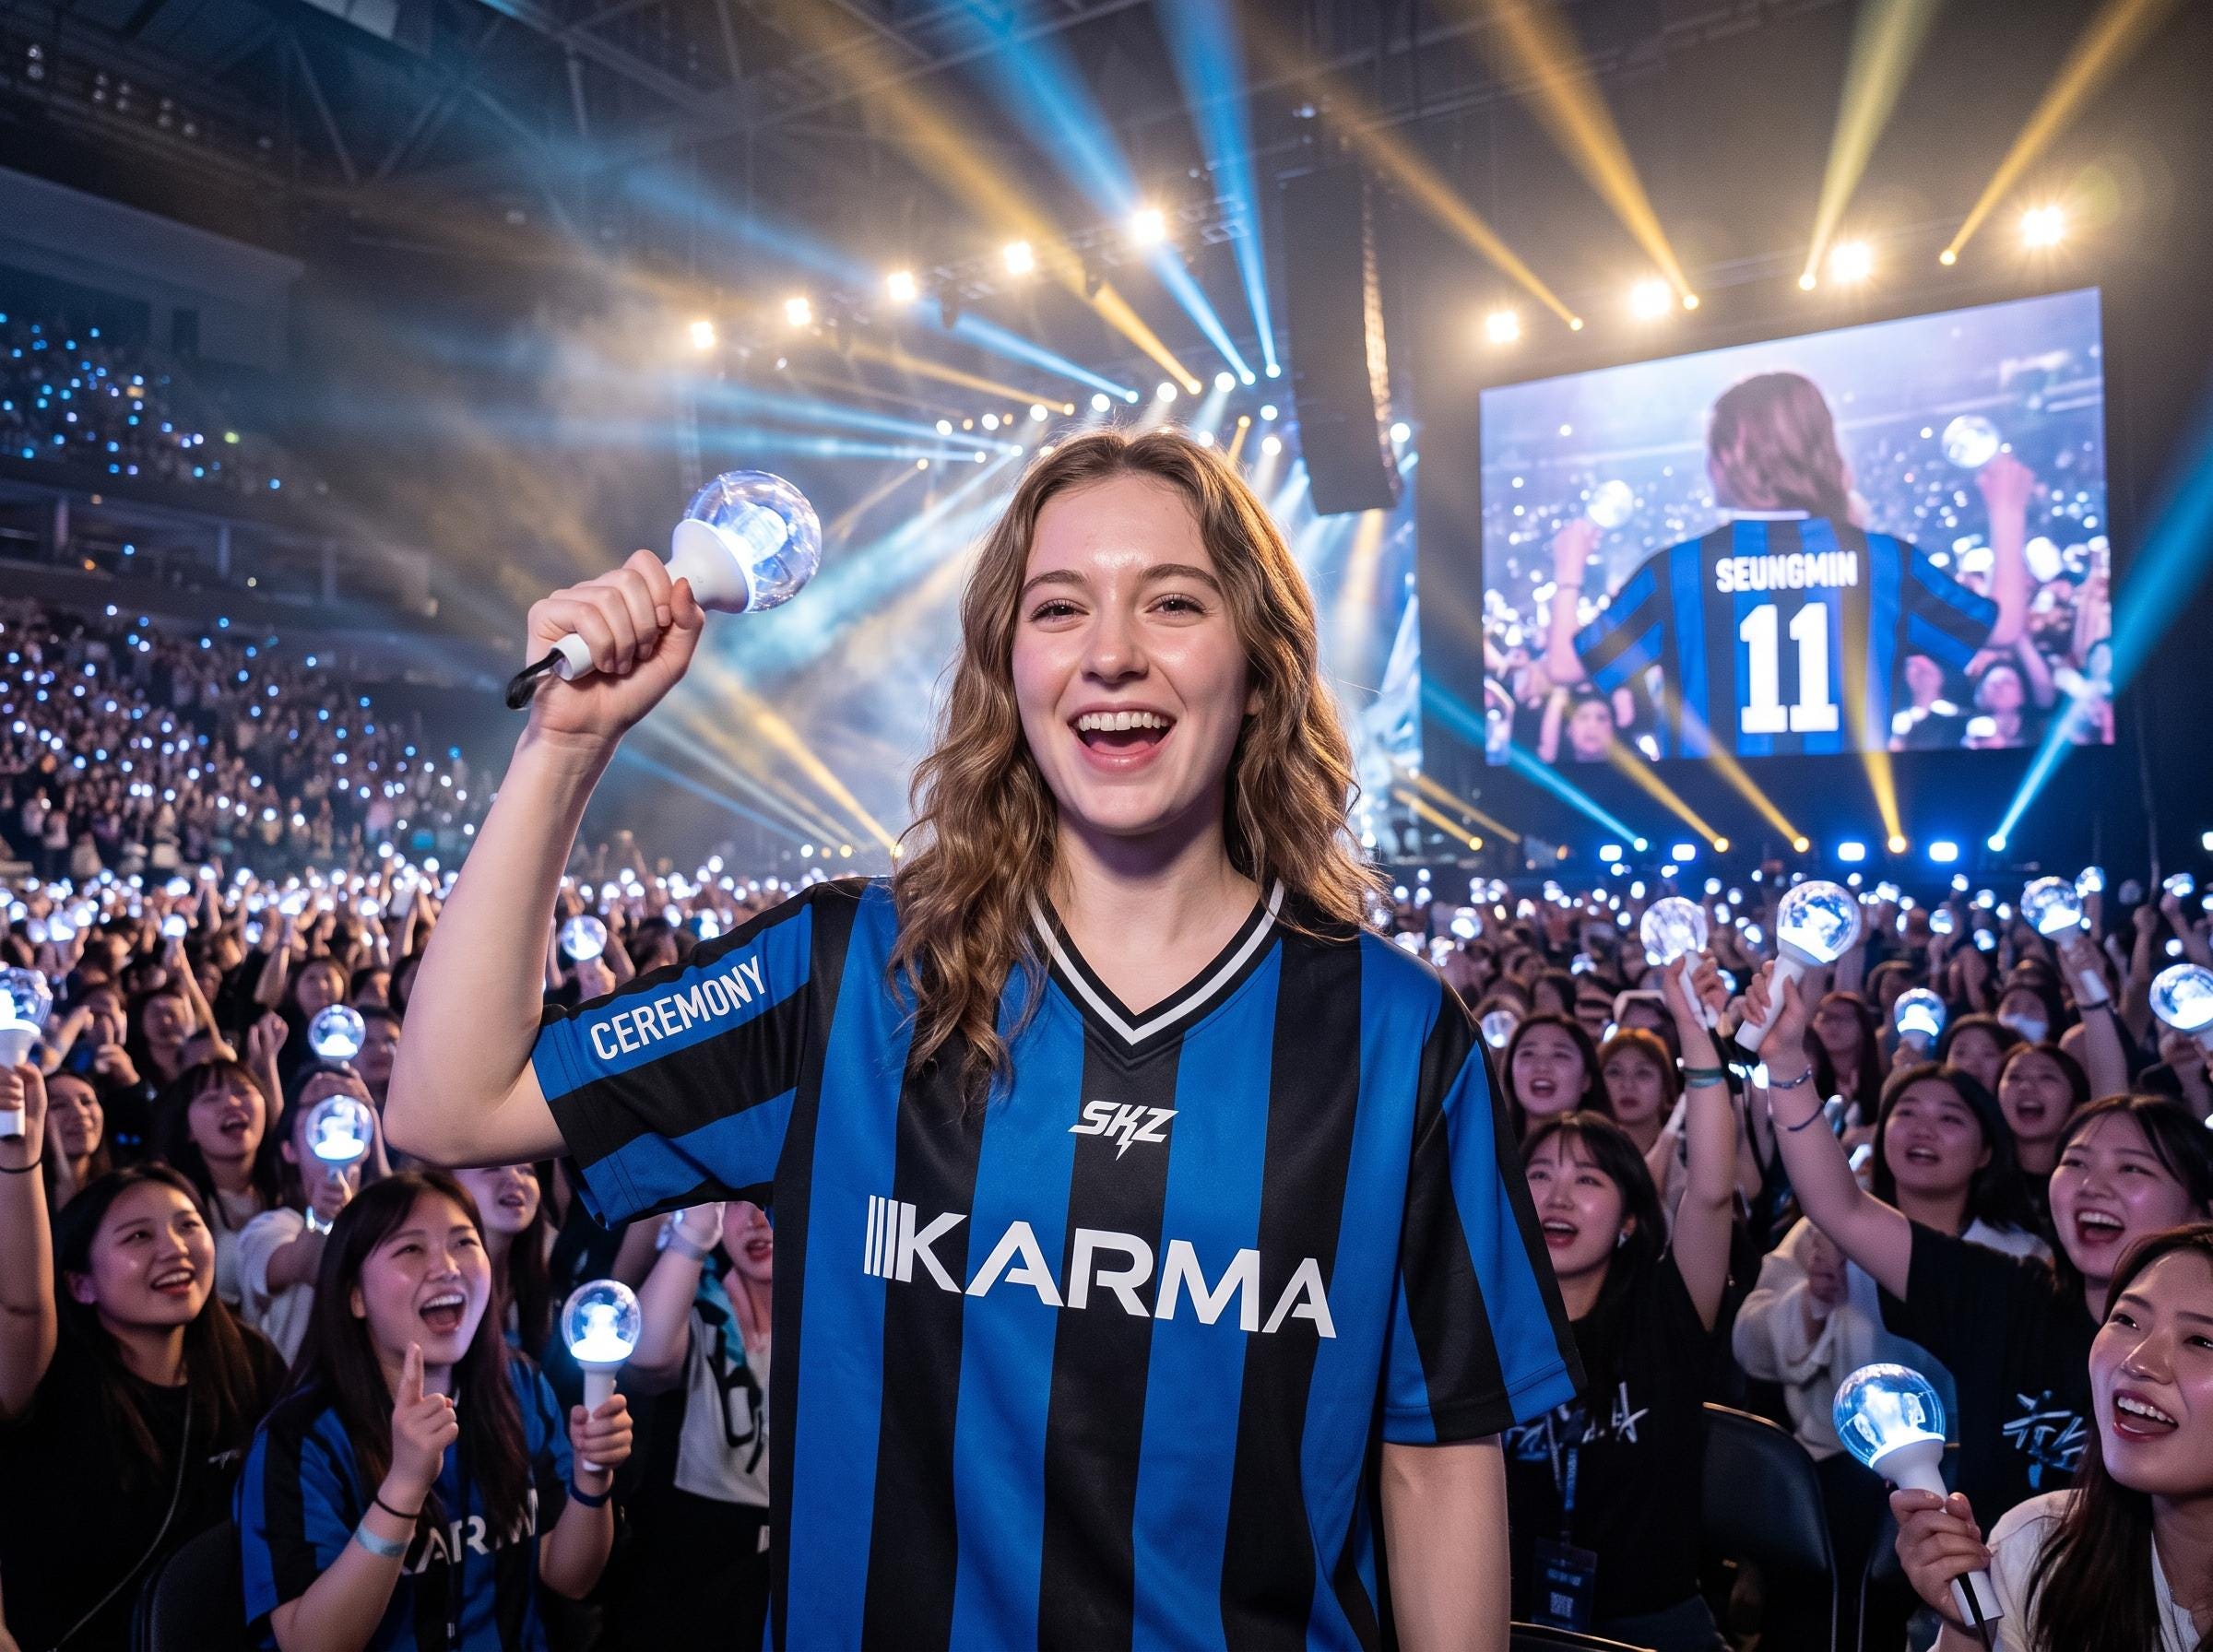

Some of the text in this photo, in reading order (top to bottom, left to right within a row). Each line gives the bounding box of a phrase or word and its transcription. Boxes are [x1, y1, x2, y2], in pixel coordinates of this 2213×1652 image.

[1716, 550, 1858, 593] SEUNGMIN
[1739, 602, 1839, 734] 11
[590, 955, 765, 1060] CEREMONY
[1068, 1100, 1178, 1161] SKZ
[863, 1195, 1337, 1339] KARMA
